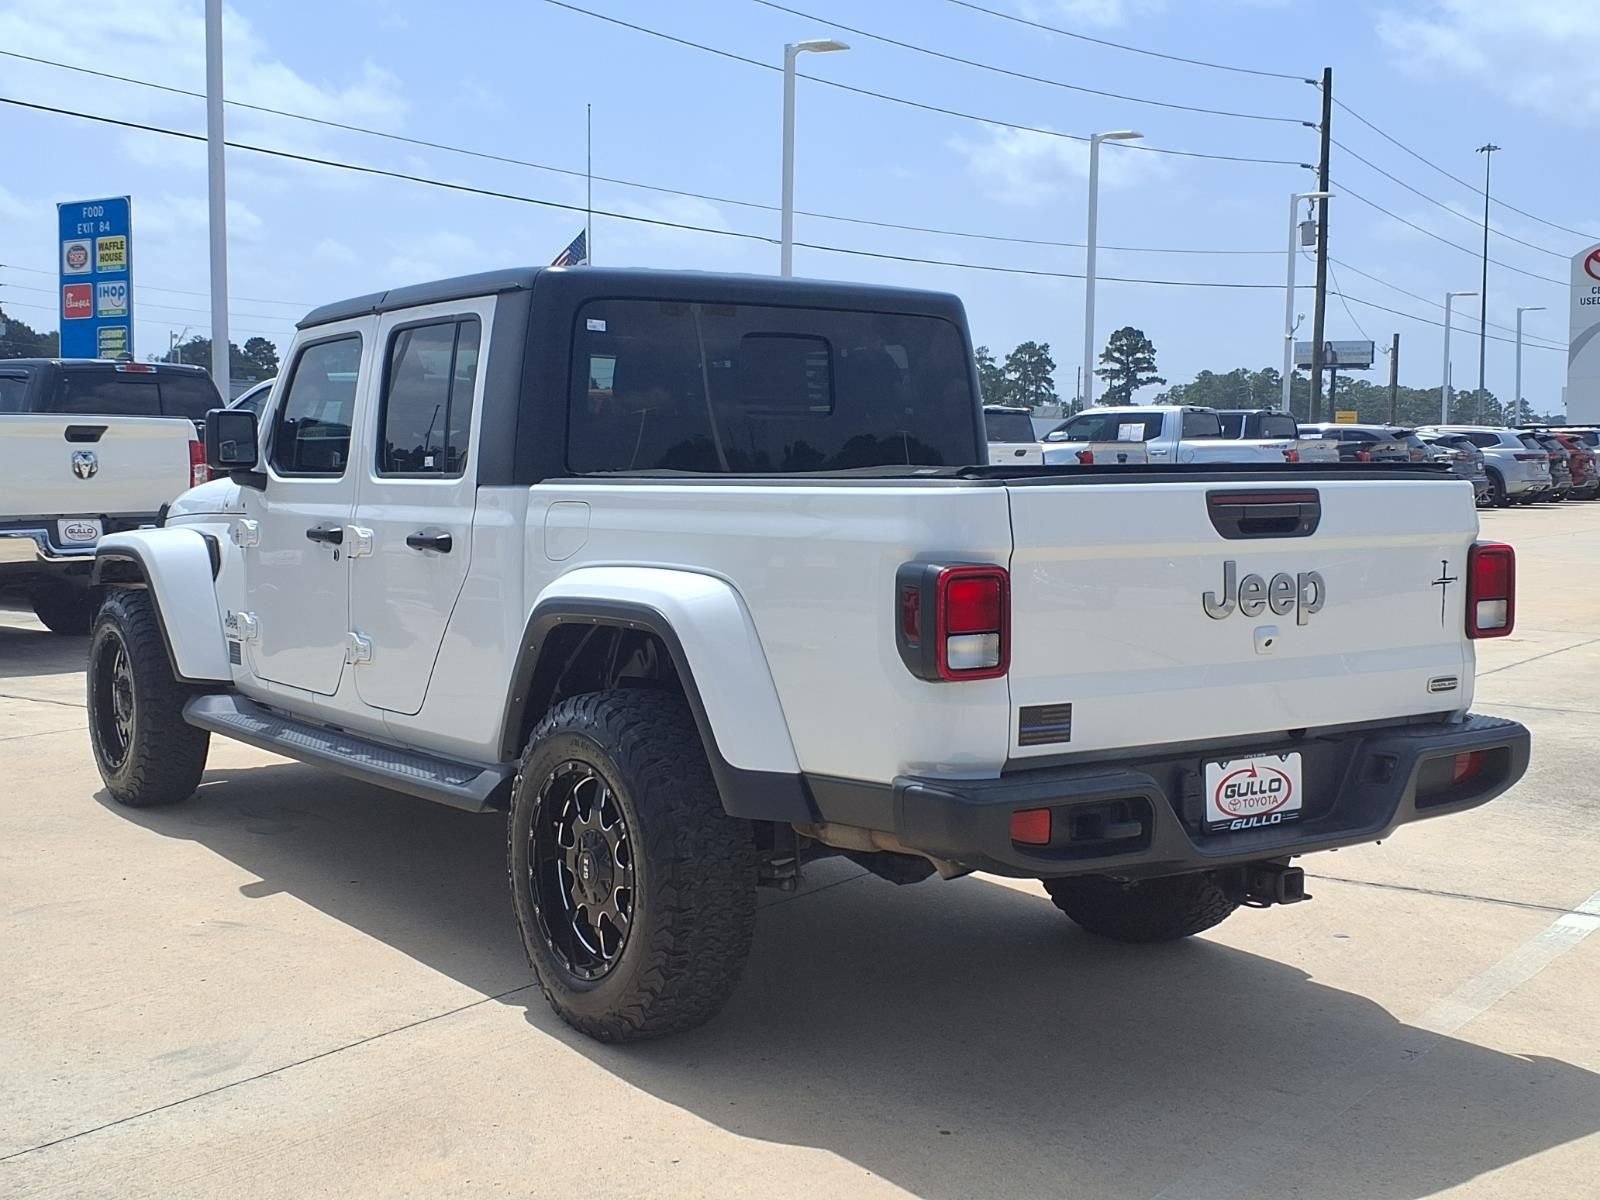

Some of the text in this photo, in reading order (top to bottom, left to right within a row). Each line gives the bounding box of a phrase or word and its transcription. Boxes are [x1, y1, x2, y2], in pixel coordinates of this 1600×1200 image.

[82, 205, 104, 218] FOOD
[77, 220, 110, 234] EXIT 84
[98, 240, 125, 251] WAFFLE
[99, 252, 123, 263] HOUSE
[1580, 296, 1600, 306] USED
[1202, 560, 1326, 626] Jeep
[1224, 777, 1282, 799] GULLO
[1243, 795, 1279, 809] TOYOTA
[1230, 813, 1282, 830] GULLO
